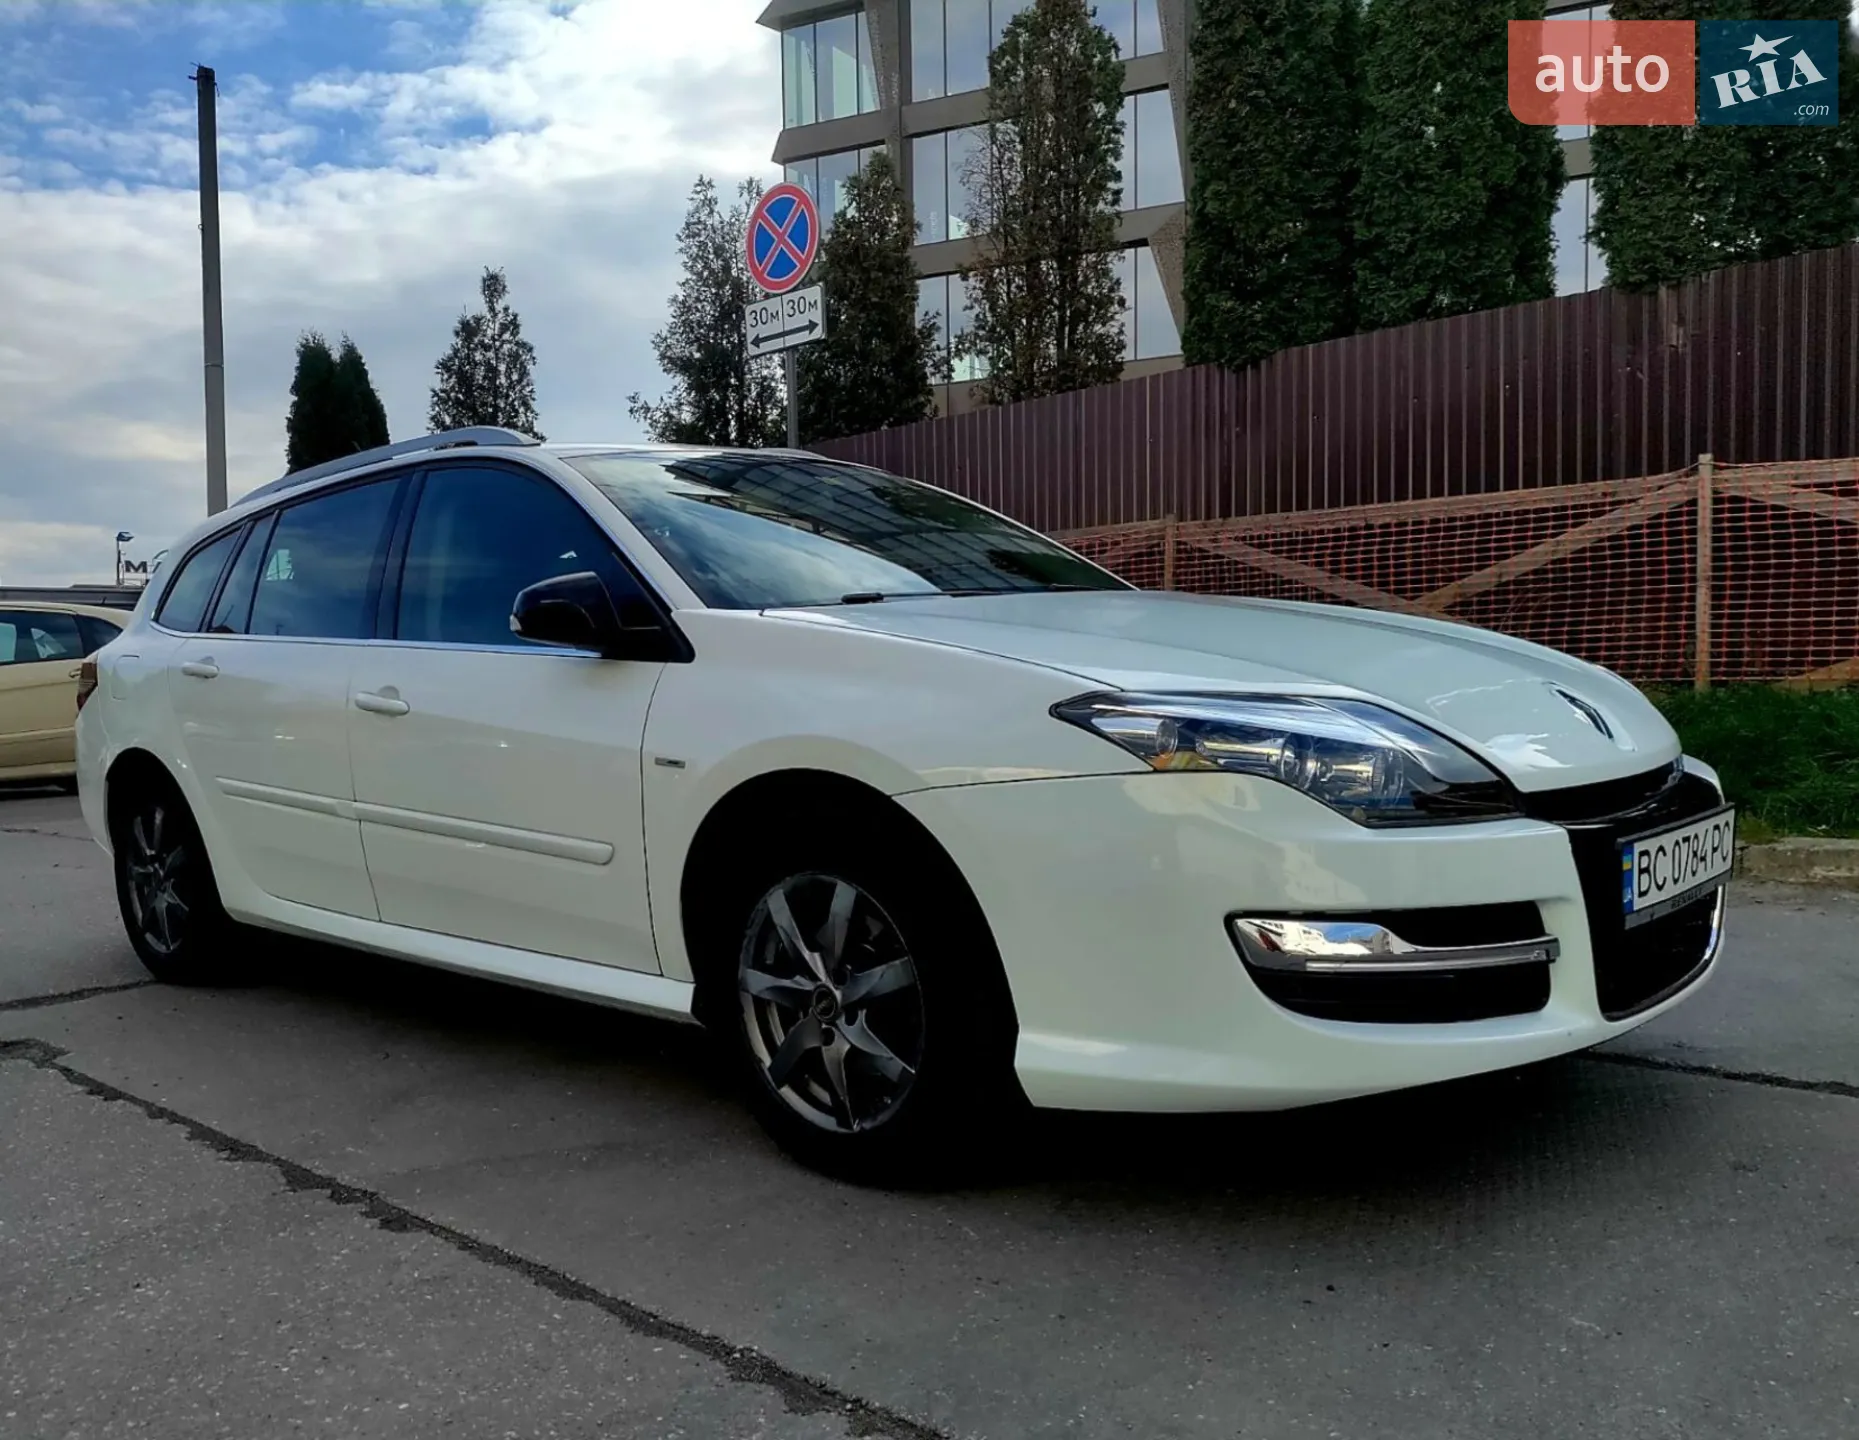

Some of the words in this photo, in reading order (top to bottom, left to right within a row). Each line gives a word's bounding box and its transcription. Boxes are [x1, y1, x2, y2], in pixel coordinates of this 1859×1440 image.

[1637, 845, 1667, 898] BC
[1672, 828, 1708, 885] 0784
[1711, 820, 1731, 869] PC
